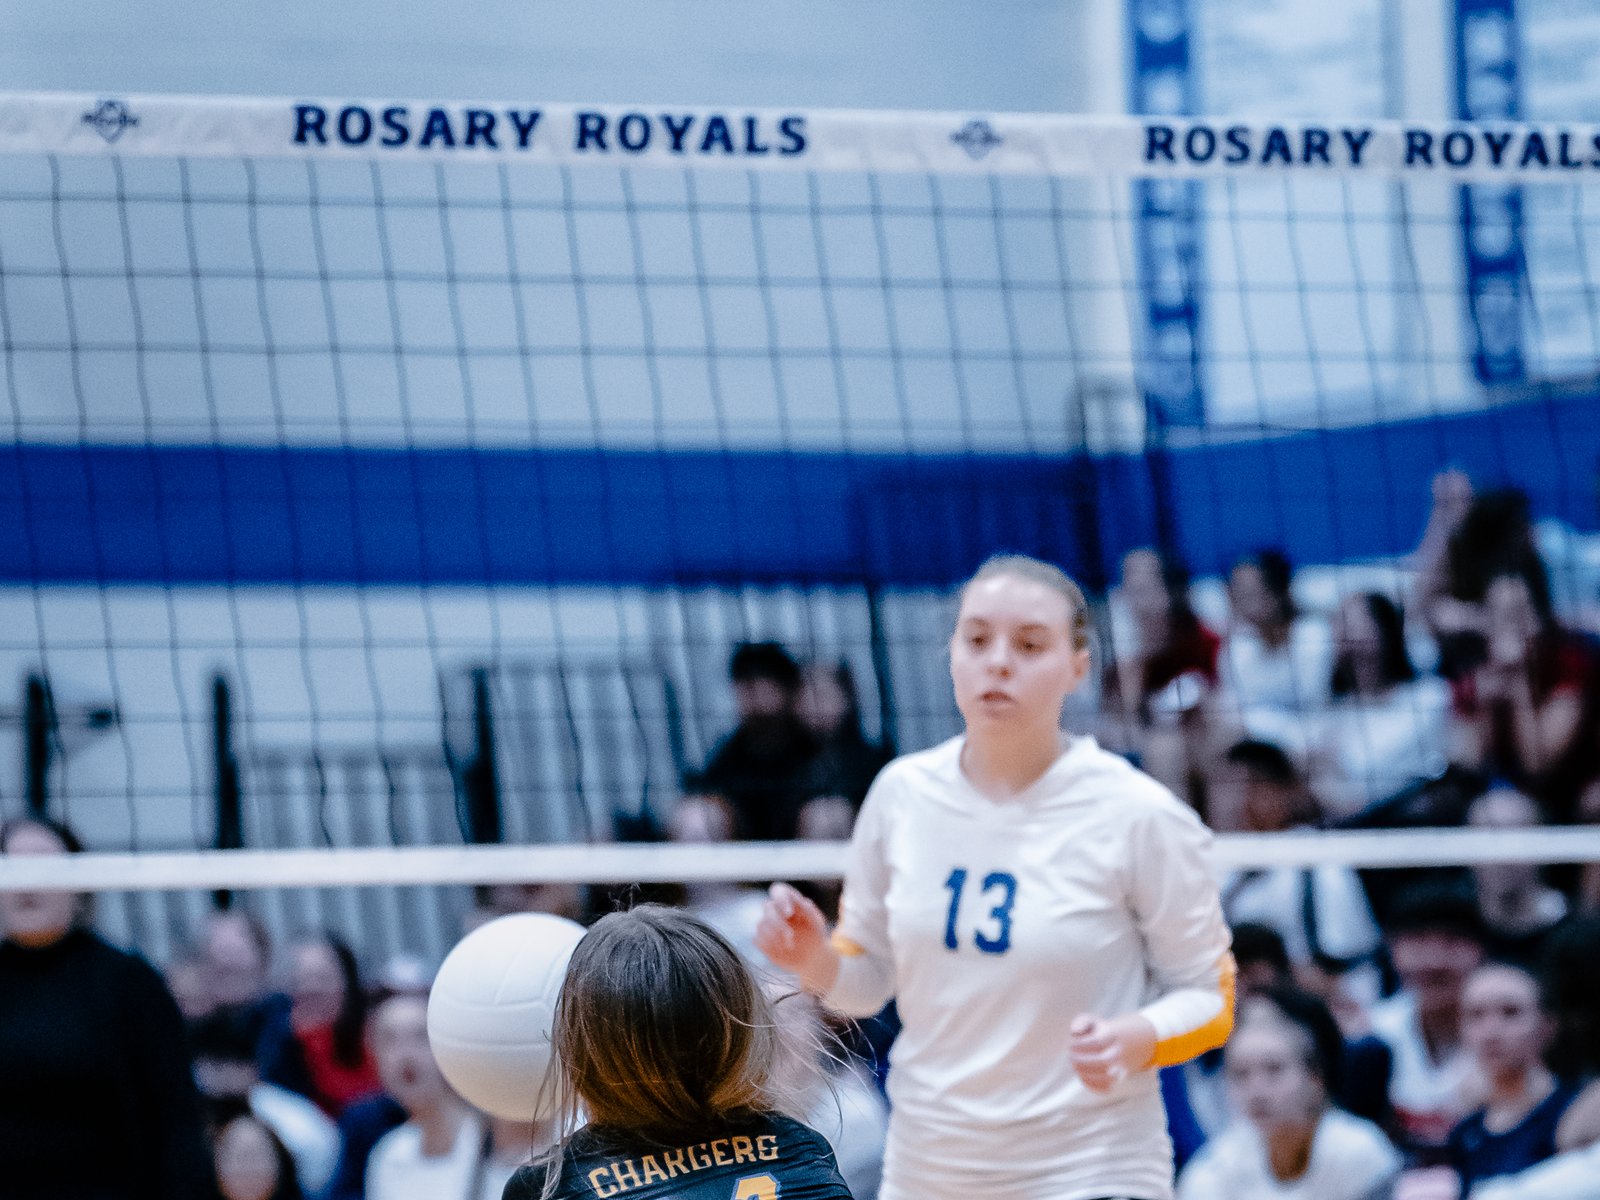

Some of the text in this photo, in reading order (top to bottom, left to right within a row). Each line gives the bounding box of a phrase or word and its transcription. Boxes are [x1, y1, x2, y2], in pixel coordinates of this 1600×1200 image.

[293, 104, 807, 153] ROSARY ROYALS
[1145, 125, 1373, 164] ROSARY
[943, 868, 1018, 954] 13
